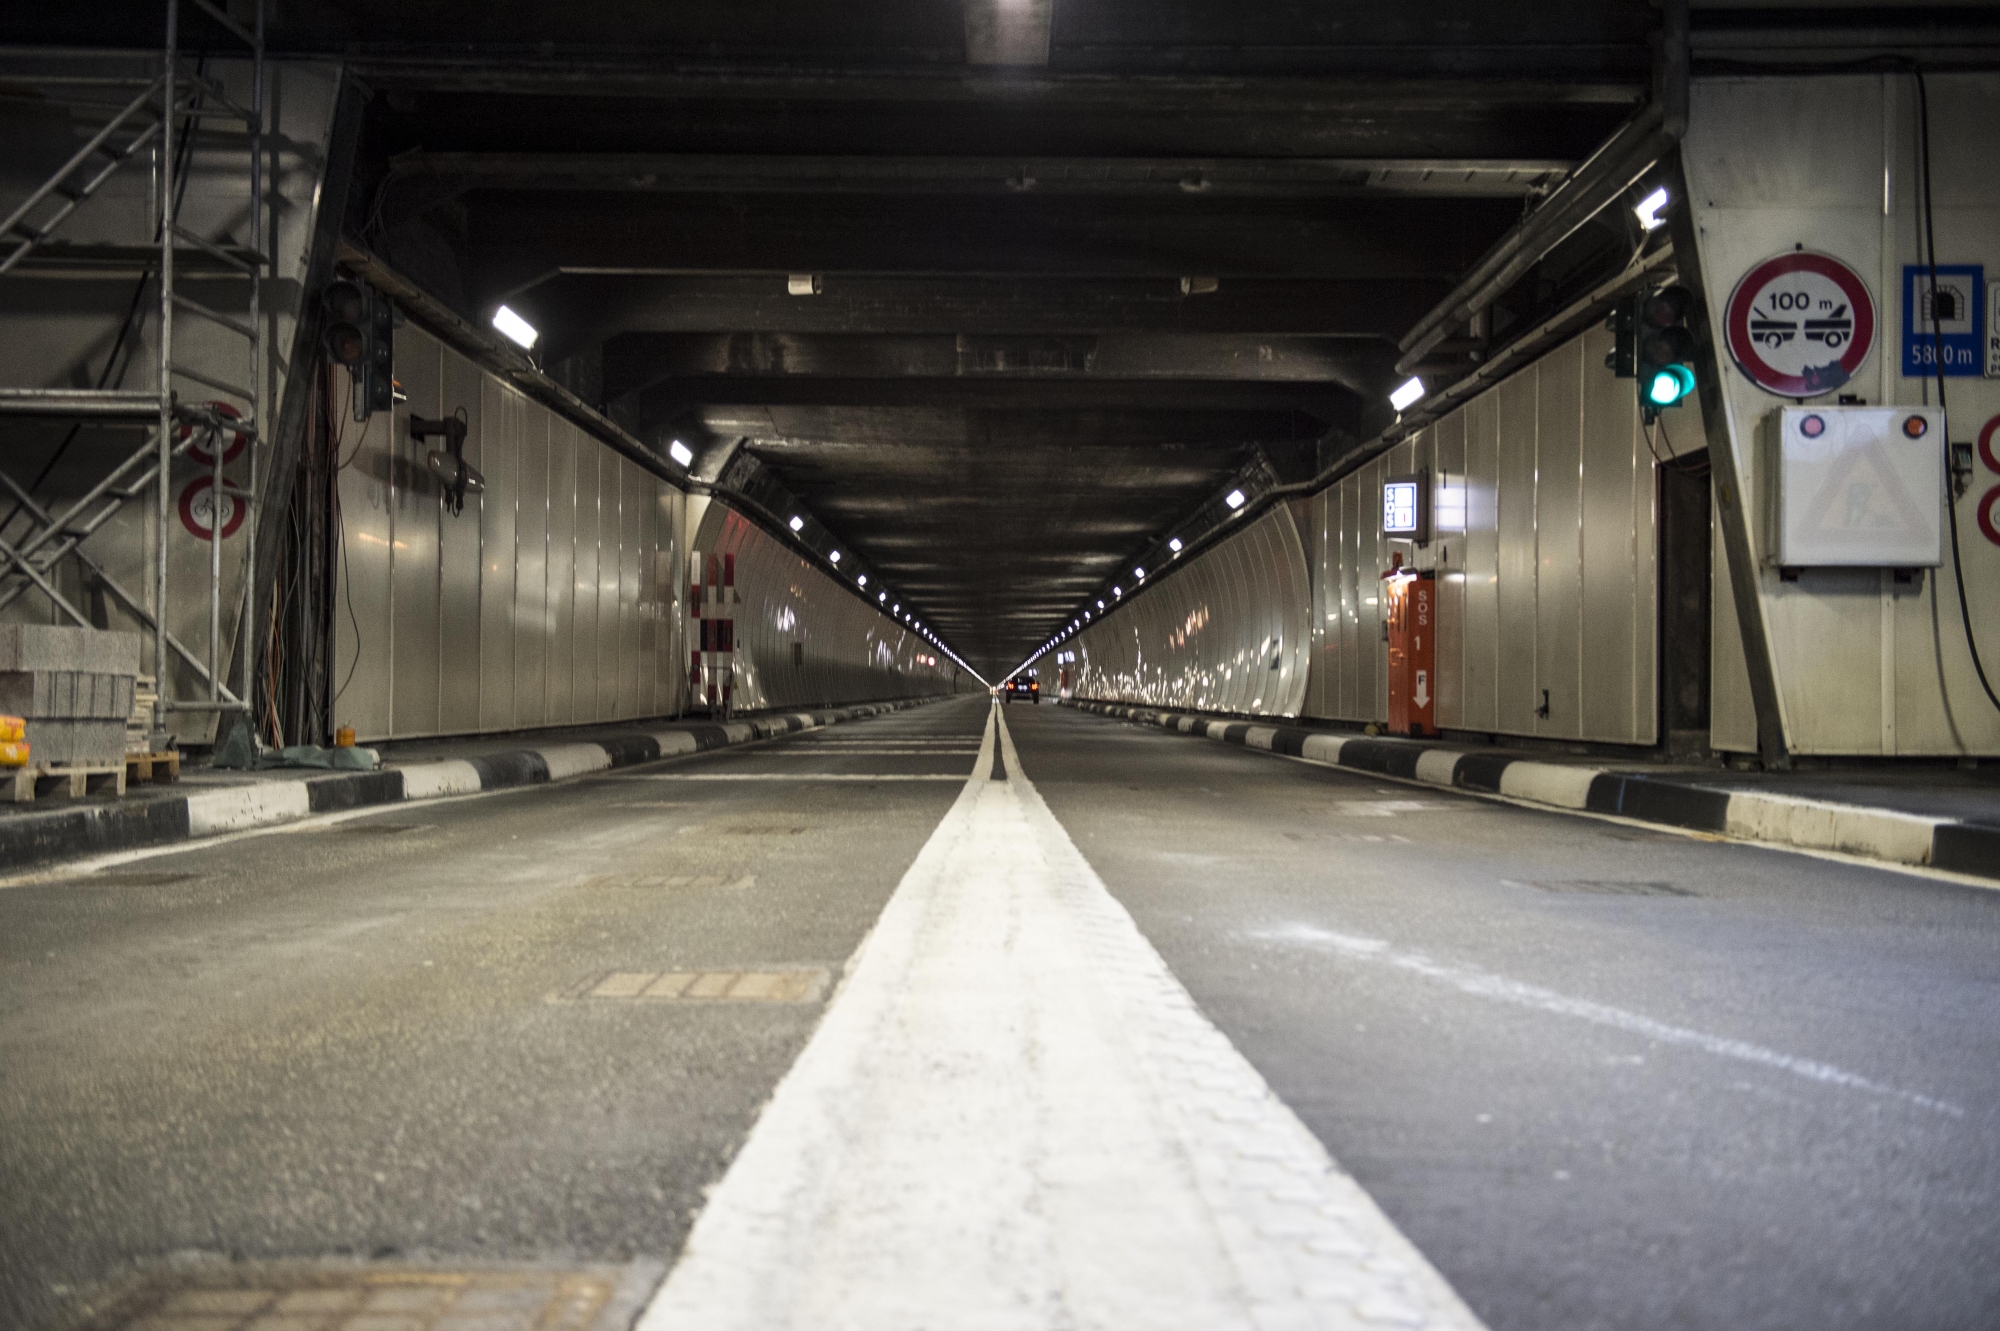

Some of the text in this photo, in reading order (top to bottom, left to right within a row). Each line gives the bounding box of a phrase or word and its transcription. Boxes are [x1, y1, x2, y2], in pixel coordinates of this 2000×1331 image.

[1769, 291, 1833, 310] 100 m
[1957, 349, 1973, 365] m
[1387, 488, 1395, 527] SOS
[1418, 589, 1428, 626] SOS
[1414, 635, 1421, 651] 1
[1418, 674, 1426, 686] F
